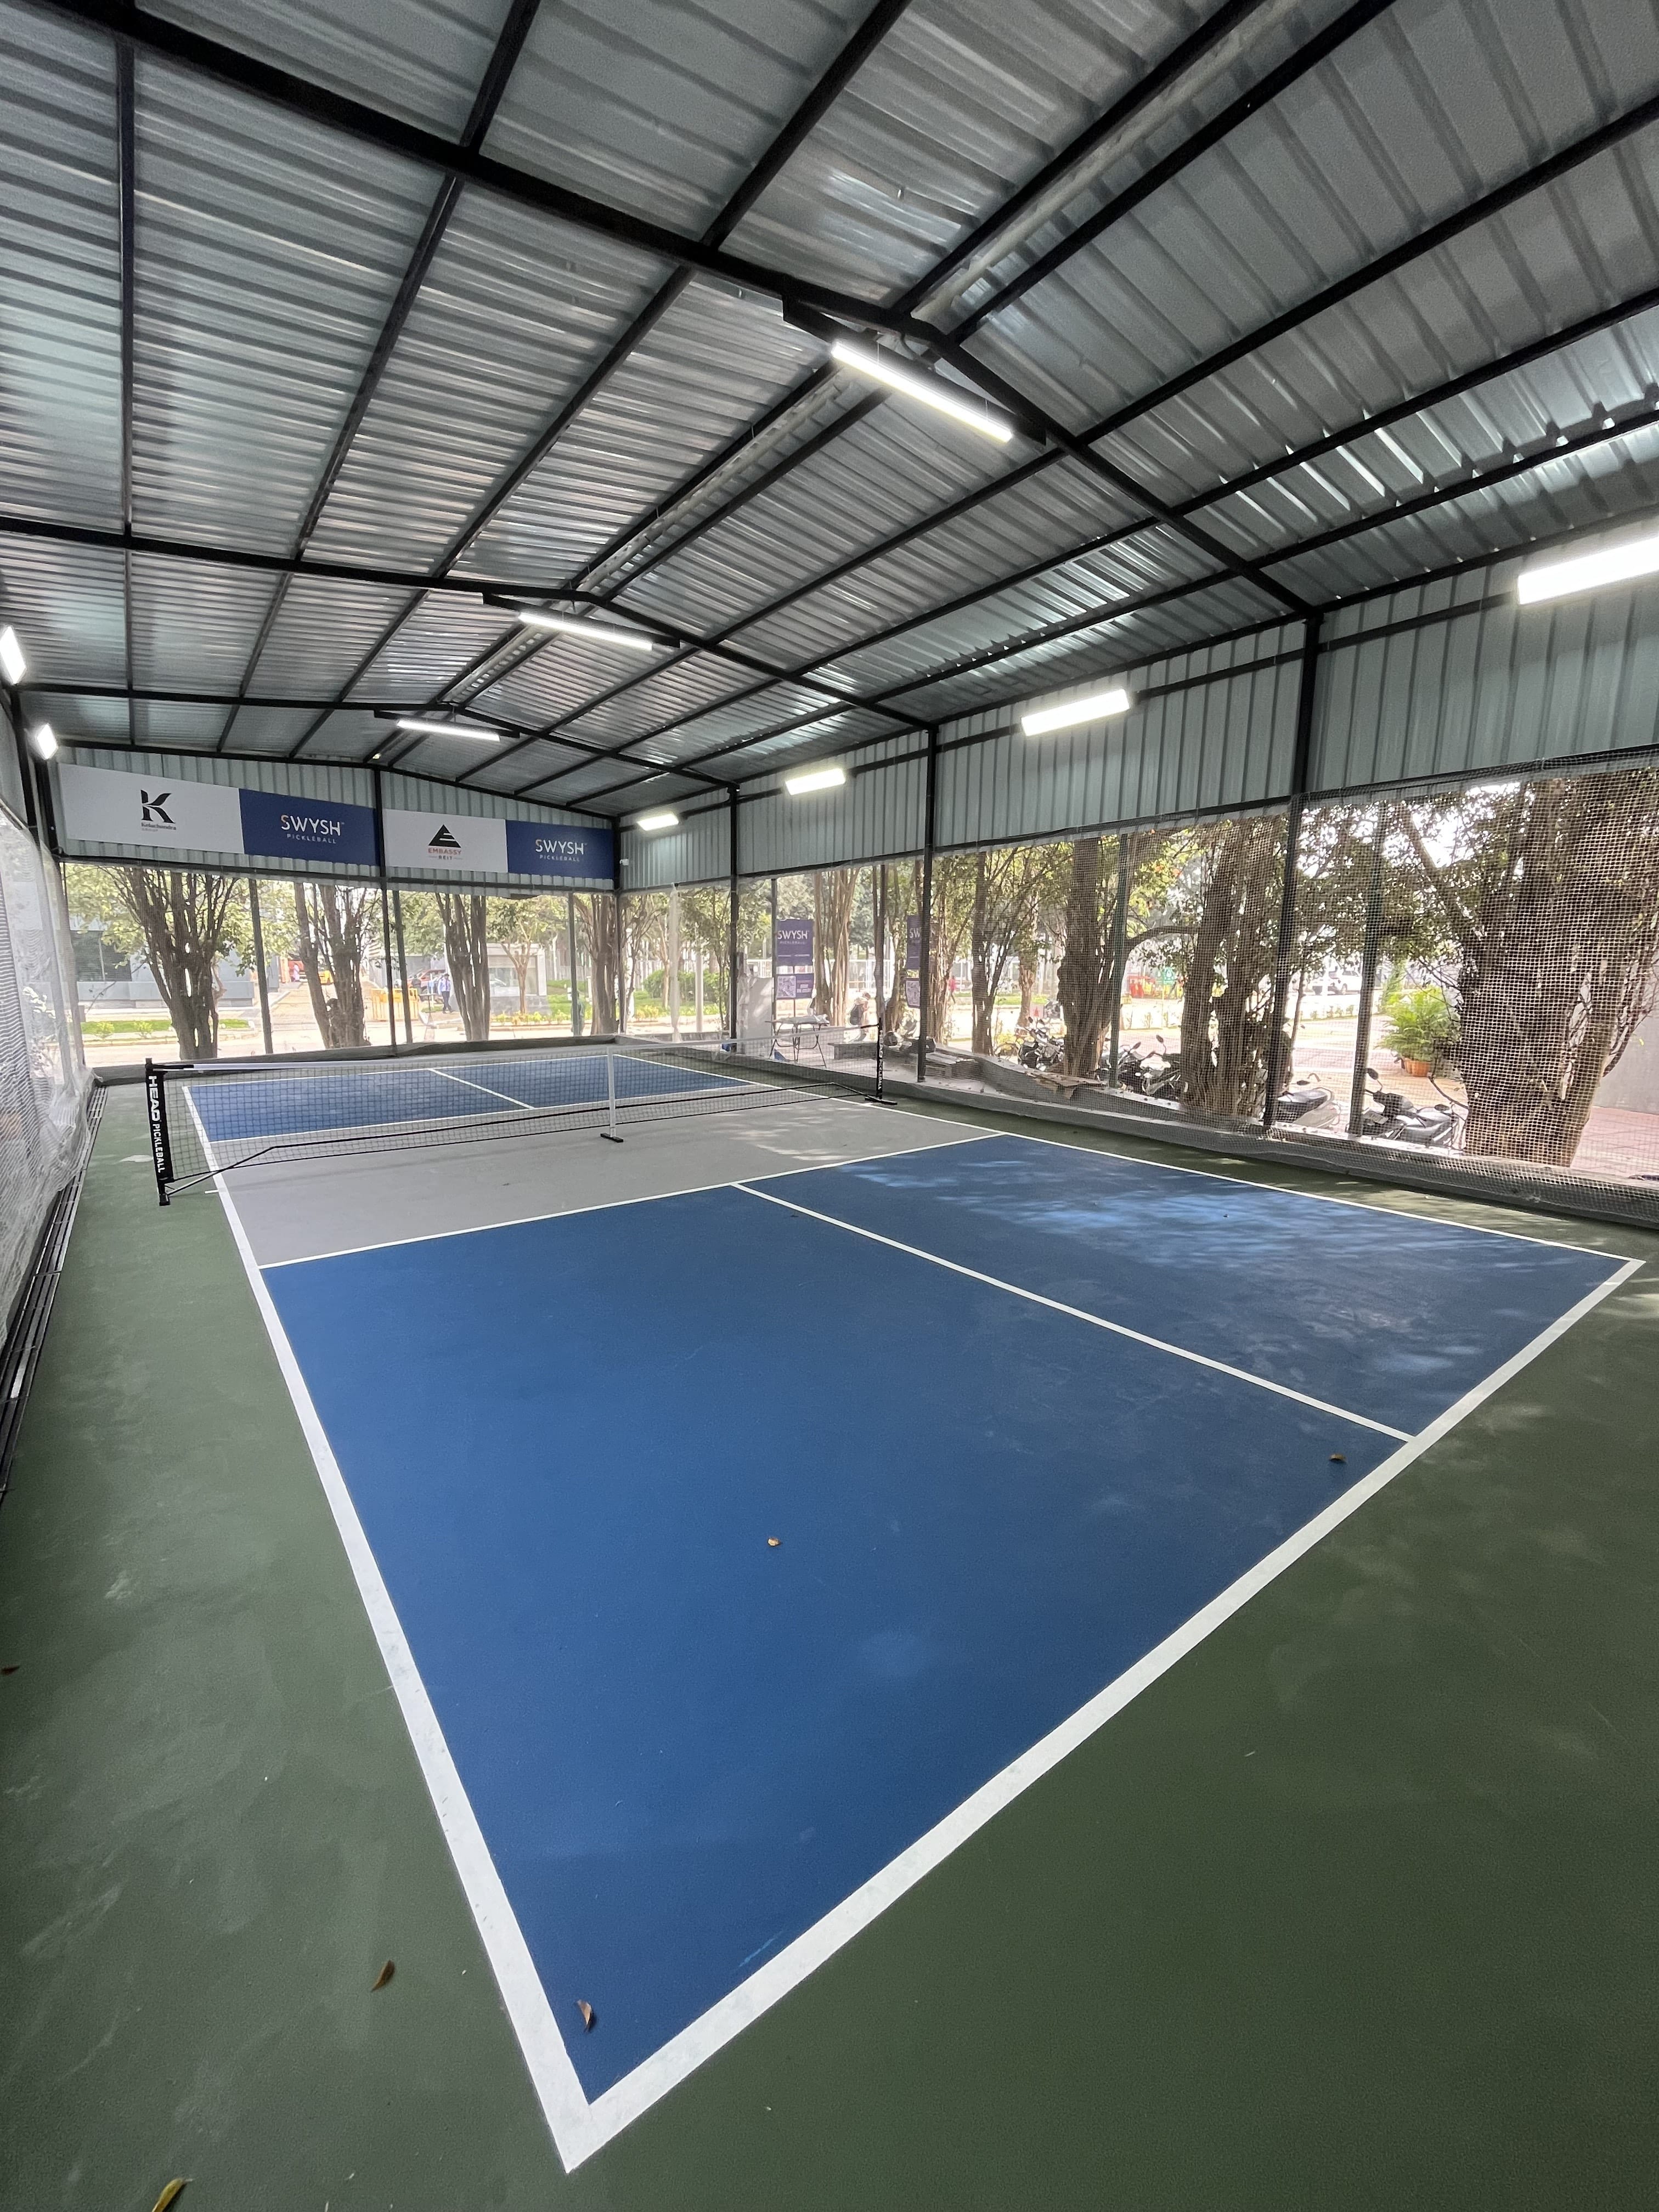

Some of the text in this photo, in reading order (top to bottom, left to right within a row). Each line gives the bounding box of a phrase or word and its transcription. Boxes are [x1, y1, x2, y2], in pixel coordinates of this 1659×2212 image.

[140, 789, 176, 823] K
[281, 815, 341, 836] SWYSH
[287, 833, 336, 844] PICKLEBALL
[535, 839, 584, 855] SWYSH
[777, 930, 808, 940] SWYSH
[148, 1076, 165, 1173] HEAD PICKLEBALL
